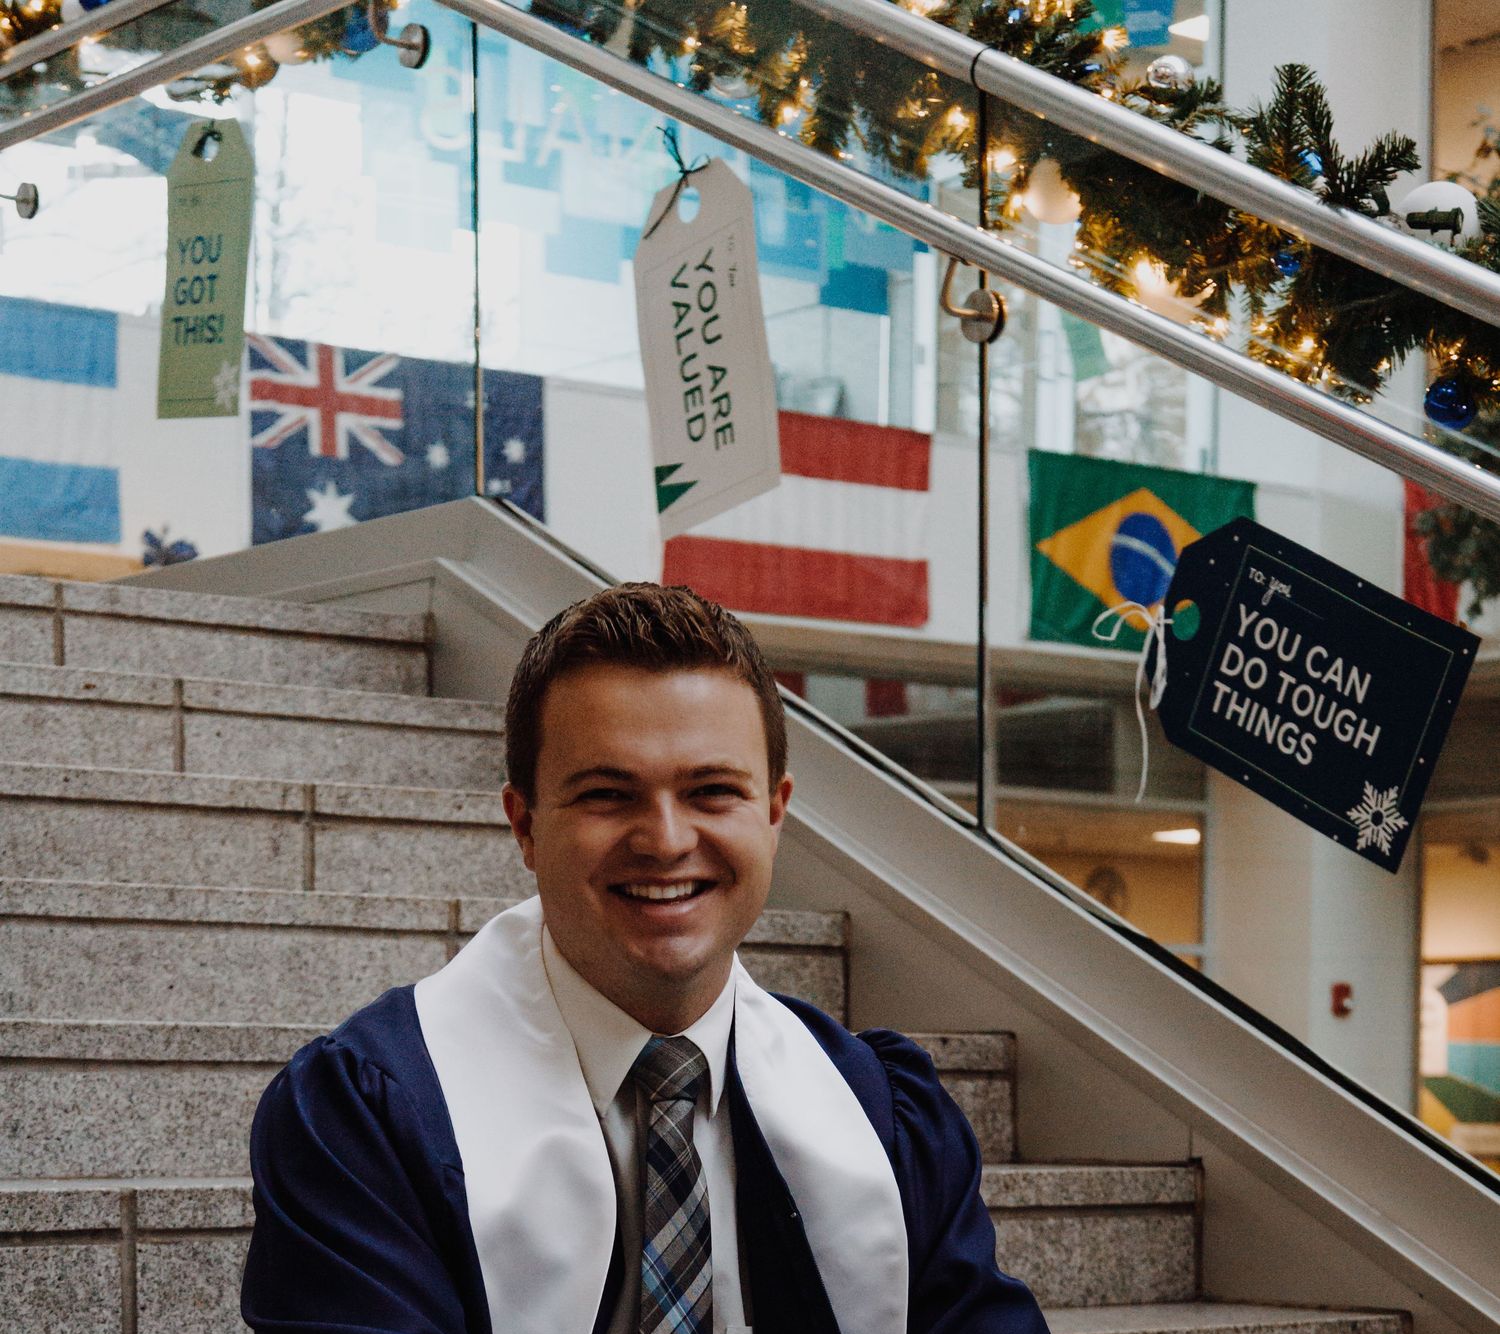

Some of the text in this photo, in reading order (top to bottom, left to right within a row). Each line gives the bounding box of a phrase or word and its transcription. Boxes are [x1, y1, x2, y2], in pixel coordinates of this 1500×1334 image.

[174, 274, 218, 305] GOT
[178, 235, 223, 264] YOU
[171, 314, 224, 345] THIS!
[670, 263, 706, 443] VALUED
[695, 247, 735, 450] YOU ARE
[1219, 642, 1381, 757] DO TOUGH
[1238, 603, 1372, 704] YOU CAN
[1212, 679, 1317, 766] THINGS
